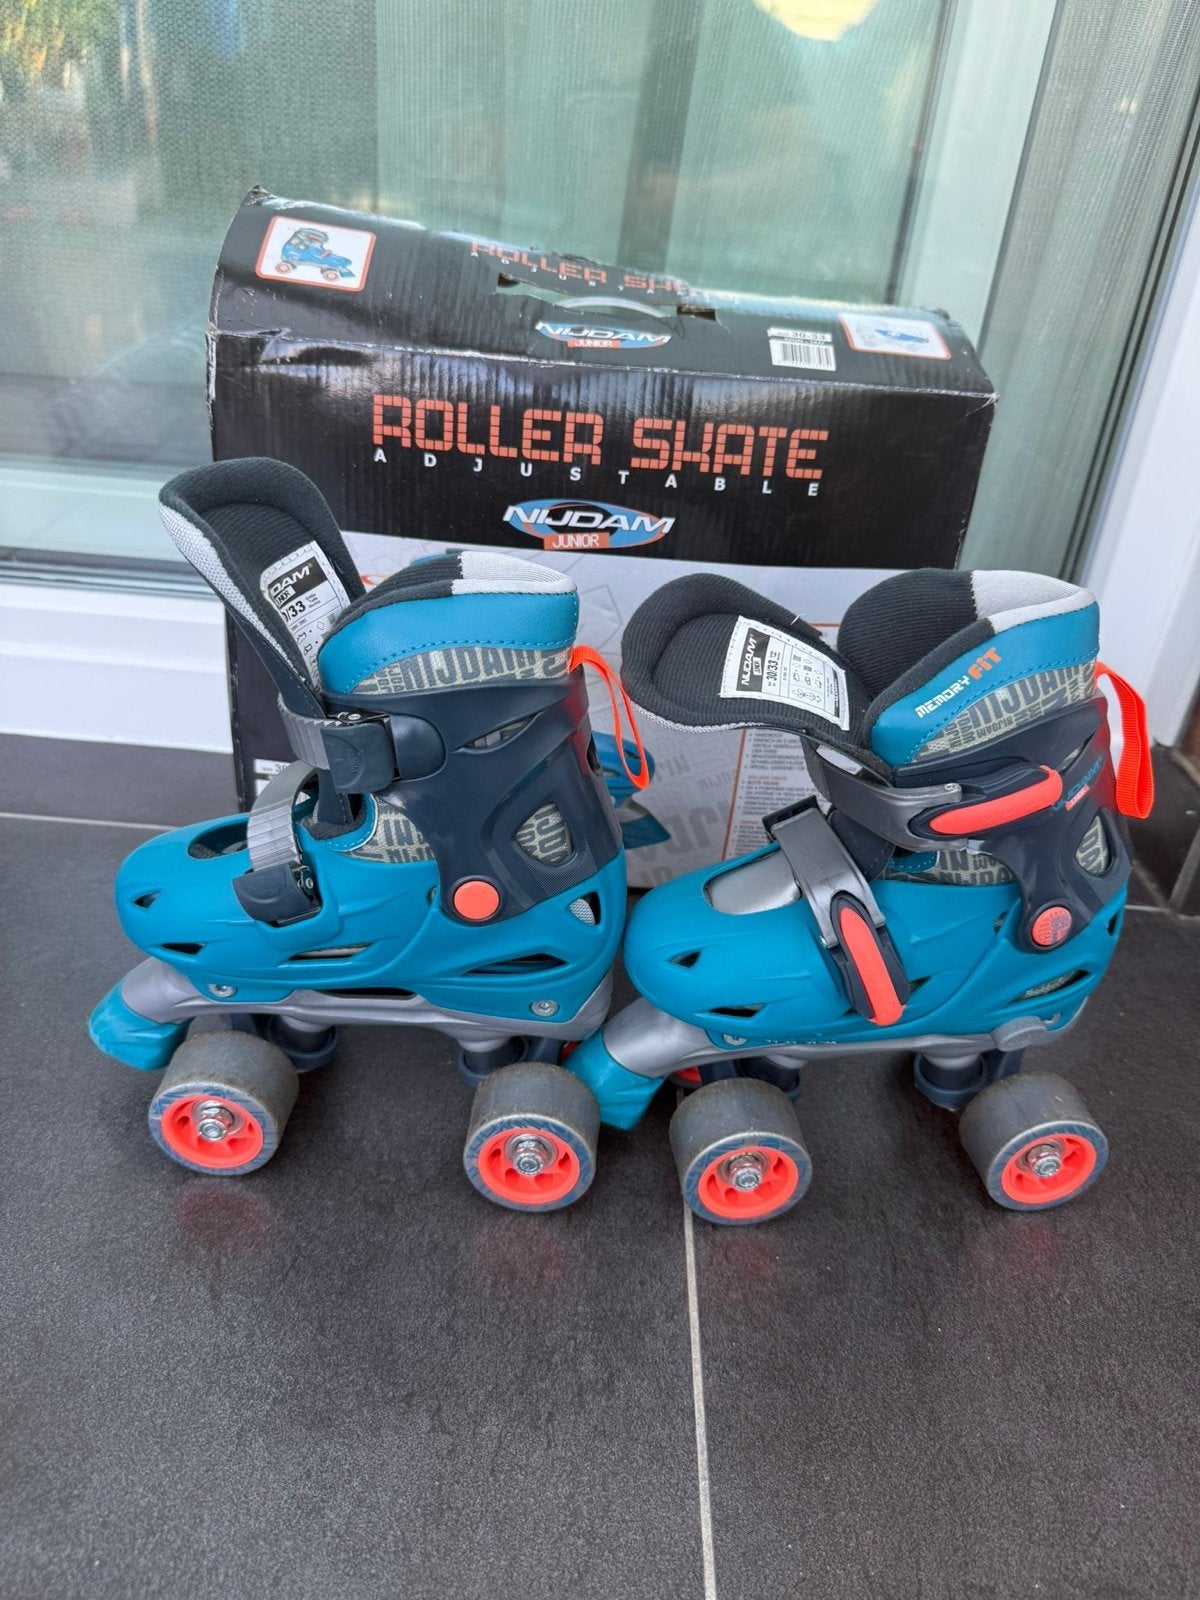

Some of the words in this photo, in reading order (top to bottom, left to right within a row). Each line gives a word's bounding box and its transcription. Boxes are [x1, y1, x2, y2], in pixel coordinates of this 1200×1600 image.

[534, 321, 671, 344] NIJDAM
[574, 339, 613, 348] JUNIOR
[372, 394, 604, 465] ROLLER
[630, 417, 829, 480] SKATE
[373, 447, 820, 496] ADJUSTABLE
[502, 504, 677, 535] NIJDAM
[552, 533, 601, 549] JUNIOR
[270, 563, 311, 595] DAM
[740, 636, 758, 686] NIJDAM
[766, 659, 779, 684] 30/33
[914, 675, 970, 718] MEMORY
